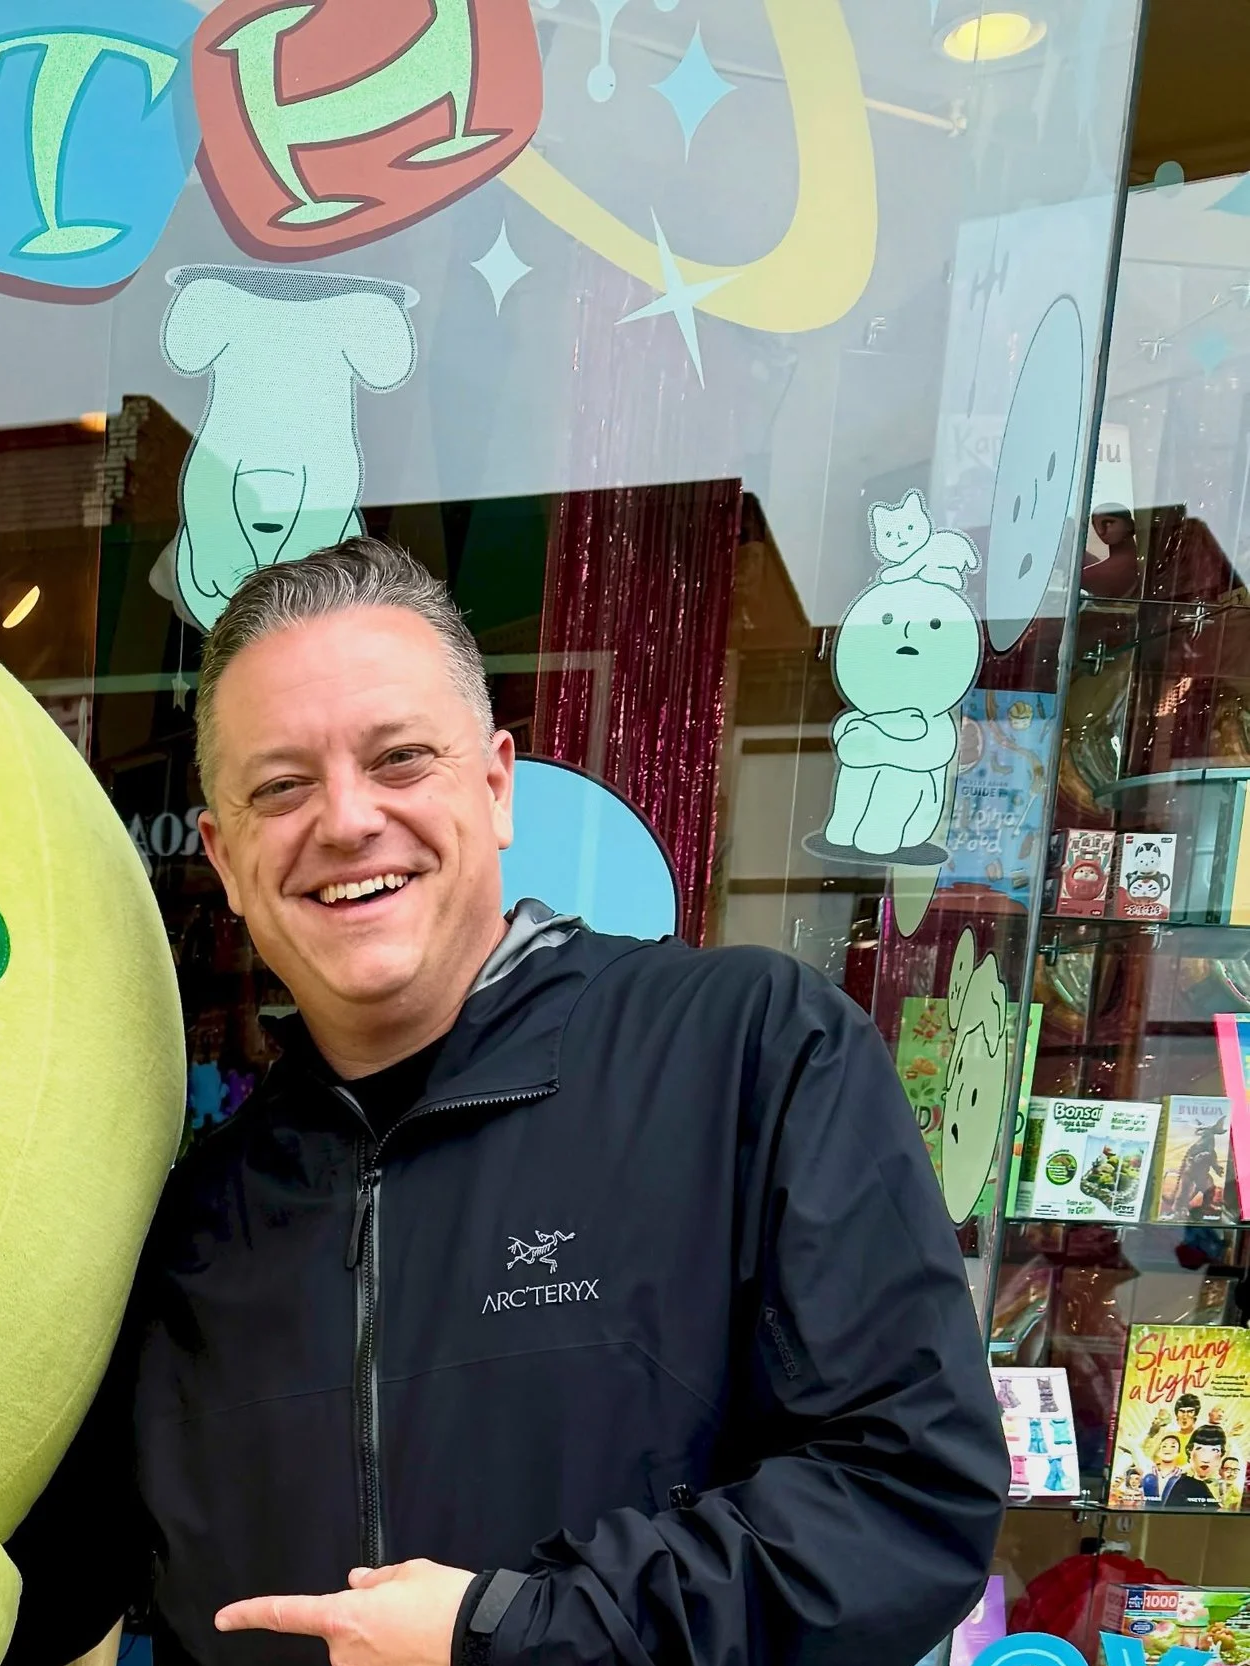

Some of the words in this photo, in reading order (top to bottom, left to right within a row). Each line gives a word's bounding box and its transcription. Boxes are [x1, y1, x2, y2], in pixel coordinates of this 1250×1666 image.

[1053, 1102, 1104, 1121] Bonsai
[481, 1278, 600, 1315] ARC'TERYX
[1134, 1332, 1234, 1370] Shining
[1129, 1384, 1141, 1400] a
[1146, 1359, 1210, 1405] Light
[1145, 1594, 1179, 1608] 1000
